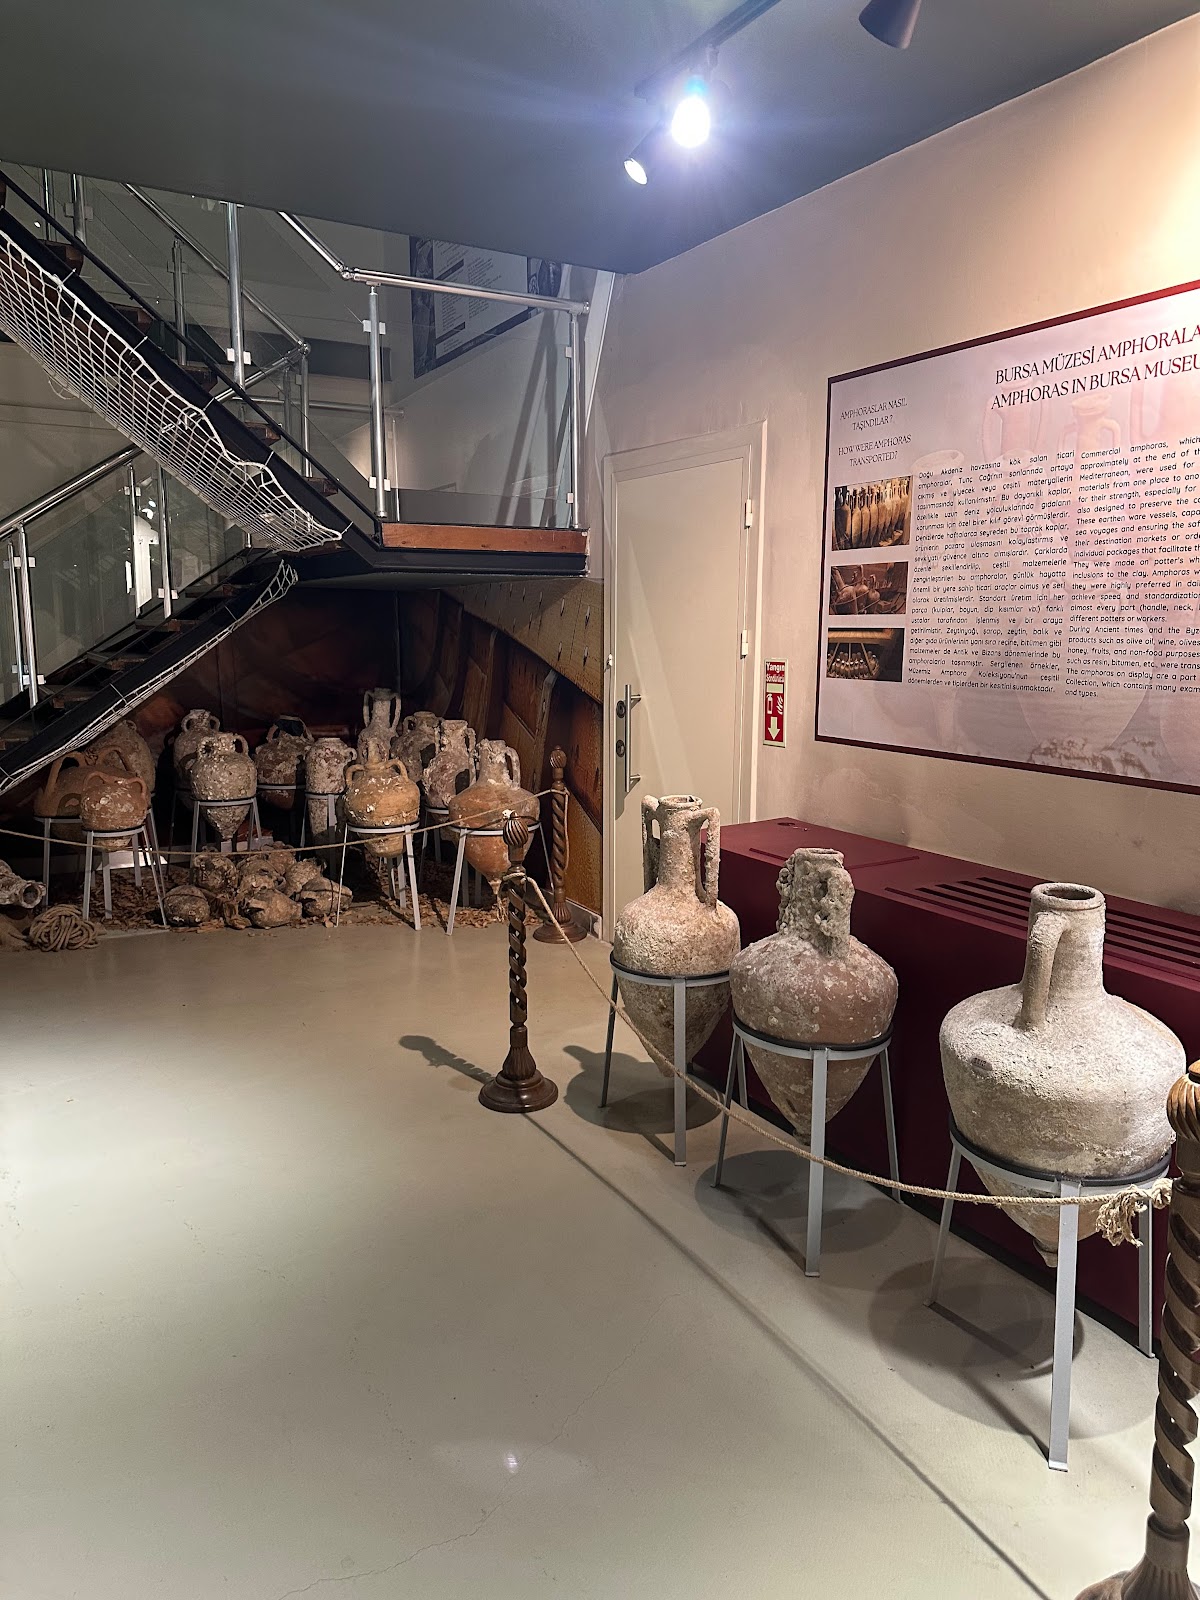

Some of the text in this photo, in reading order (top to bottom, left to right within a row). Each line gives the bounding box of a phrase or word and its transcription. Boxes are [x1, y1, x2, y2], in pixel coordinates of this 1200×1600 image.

[996, 362, 1039, 384] BURSA
[1042, 346, 1094, 374] MÜZESİ
[991, 381, 1069, 410] AMPHORAS
[1072, 377, 1087, 393] IN
[1089, 367, 1141, 390] BURSA
[840, 402, 887, 420] AMPHORASLAR
[852, 416, 888, 431] TAŞINDILAR
[839, 434, 911, 455] HOW WERE AMPHORAS
[1081, 447, 1120, 458] Commercial
[1130, 442, 1168, 452] amphoras,
[850, 451, 898, 466] TRANSPORTED?
[1030, 455, 1047, 463] salan
[1057, 450, 1074, 459] ticari
[1081, 458, 1128, 470] approximately
[1028, 475, 1072, 486] materyallerin
[1080, 471, 1130, 480] Mediterranean,
[1079, 483, 1109, 492] materials
[1150, 477, 1169, 485] place
[1110, 491, 1140, 500] strength,
[1145, 487, 1180, 497] especially
[1077, 506, 1090, 514] also
[1094, 504, 1124, 512] designed
[1140, 499, 1172, 510] preserve
[1004, 515, 1023, 524] görevi
[1099, 515, 1125, 523] earthen
[1150, 511, 1177, 519] vessels,
[1090, 527, 1118, 535] voyages
[1138, 522, 1168, 531] ensuring
[1094, 537, 1131, 545] destination
[1137, 535, 1166, 543] markets
[1185, 532, 1200, 540] ord
[1035, 547, 1067, 555] Çarklarda
[1074, 549, 1104, 557] individual
[1107, 548, 1139, 557] packages
[1023, 559, 1066, 567] malzemelerle
[1074, 561, 1089, 569] They
[1154, 557, 1183, 565] potter's
[1013, 571, 1066, 580] günlük hayatta
[1118, 569, 1128, 577] the
[1133, 570, 1148, 578] clay.
[1072, 582, 1086, 590] they
[1111, 581, 1131, 589] highly
[1136, 581, 1170, 589] preferred
[1101, 593, 1120, 601] speed
[1145, 591, 1200, 599] standardizatio
[1049, 640, 1061, 648] gibi
[1068, 647, 1088, 655] honey,
[1112, 659, 1141, 667] bitumen,
[1129, 671, 1153, 680] display
[1066, 679, 1098, 687] Collection,
